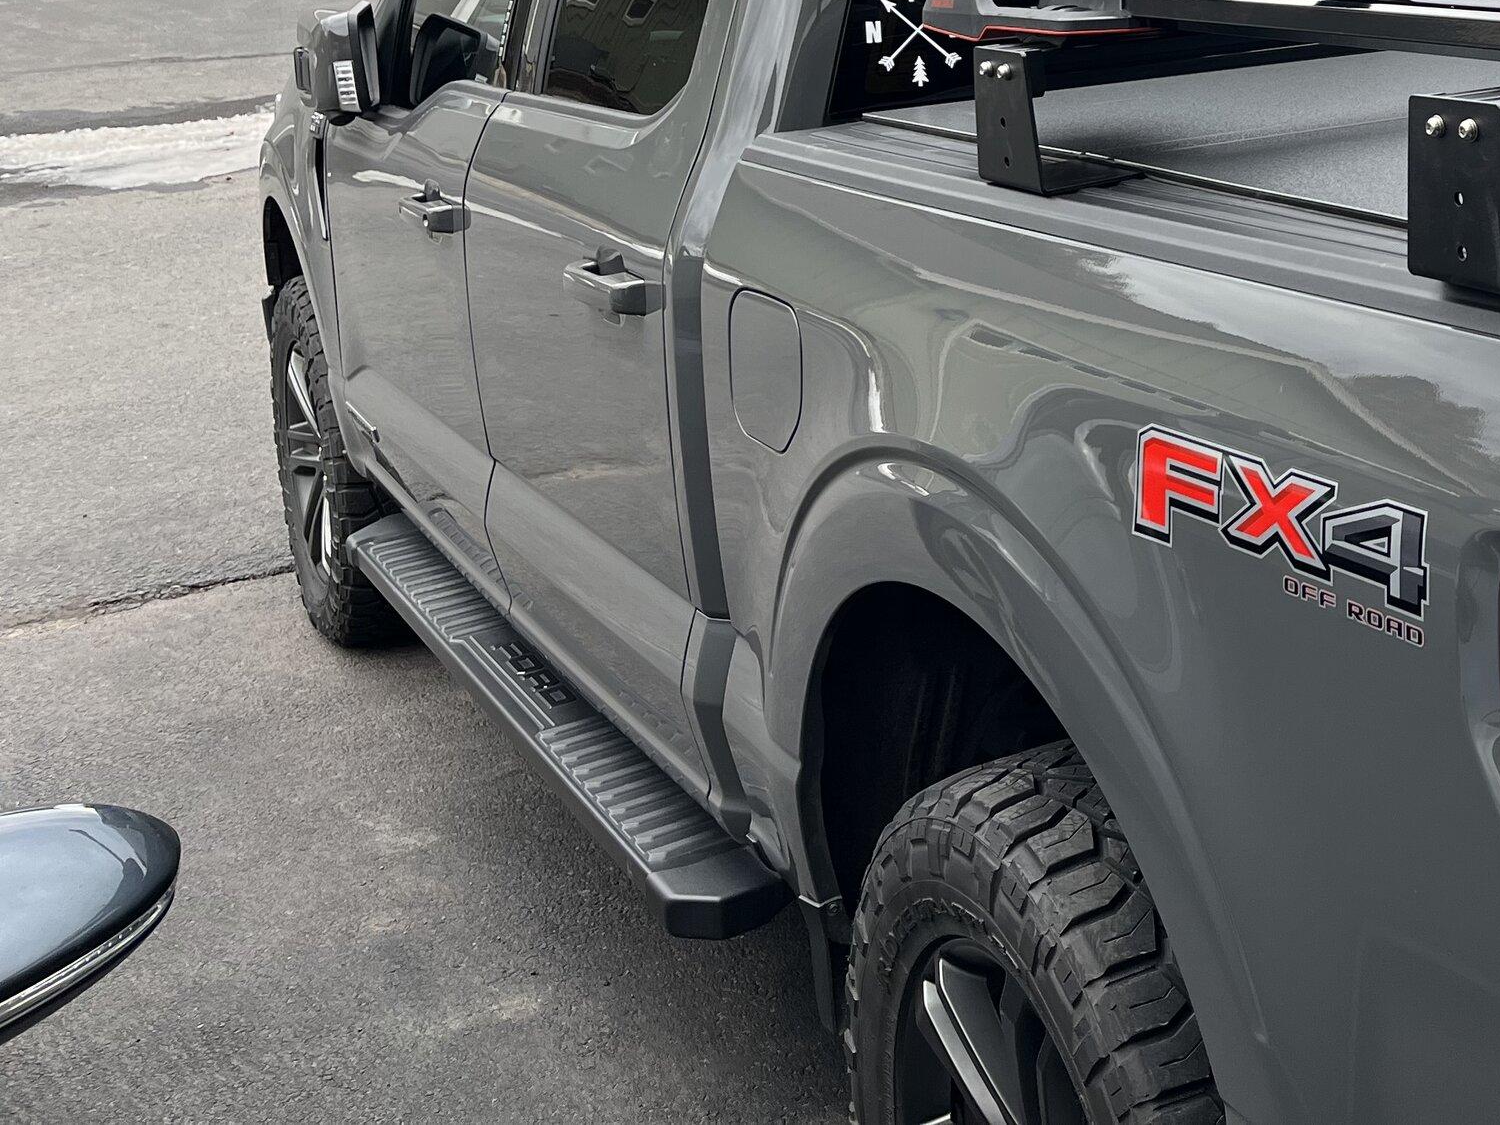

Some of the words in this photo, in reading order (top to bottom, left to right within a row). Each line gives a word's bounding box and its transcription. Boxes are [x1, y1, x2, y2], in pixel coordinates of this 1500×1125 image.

[865, 20, 882, 44] N
[1132, 423, 1429, 621] FX4
[1283, 575, 1336, 609] OFF
[1346, 598, 1425, 648] ROAD
